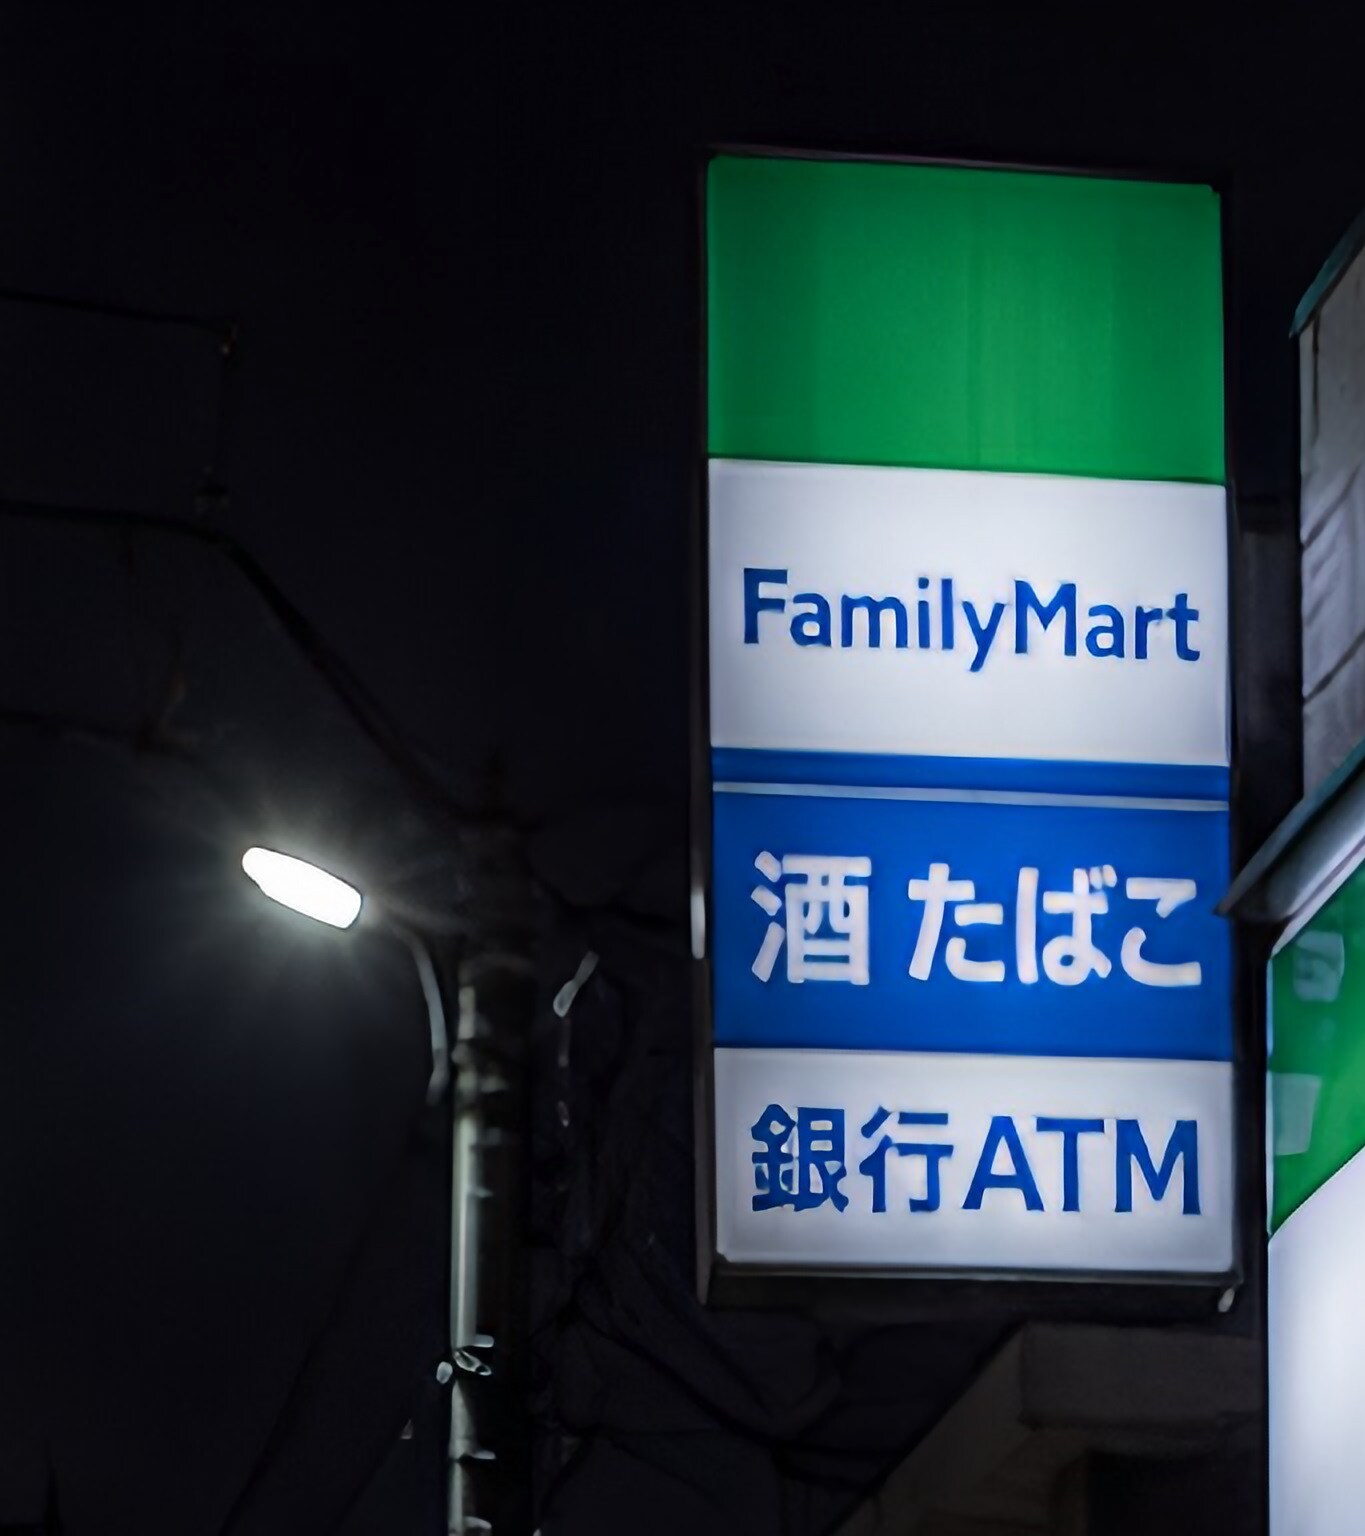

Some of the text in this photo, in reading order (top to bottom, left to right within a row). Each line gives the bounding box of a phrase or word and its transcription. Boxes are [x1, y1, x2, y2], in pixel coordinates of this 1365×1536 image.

[742, 567, 1202, 672] FamilyMart
[751, 850, 1204, 988] 酒 たばこ
[751, 1103, 1203, 1216] 銀行ATM
